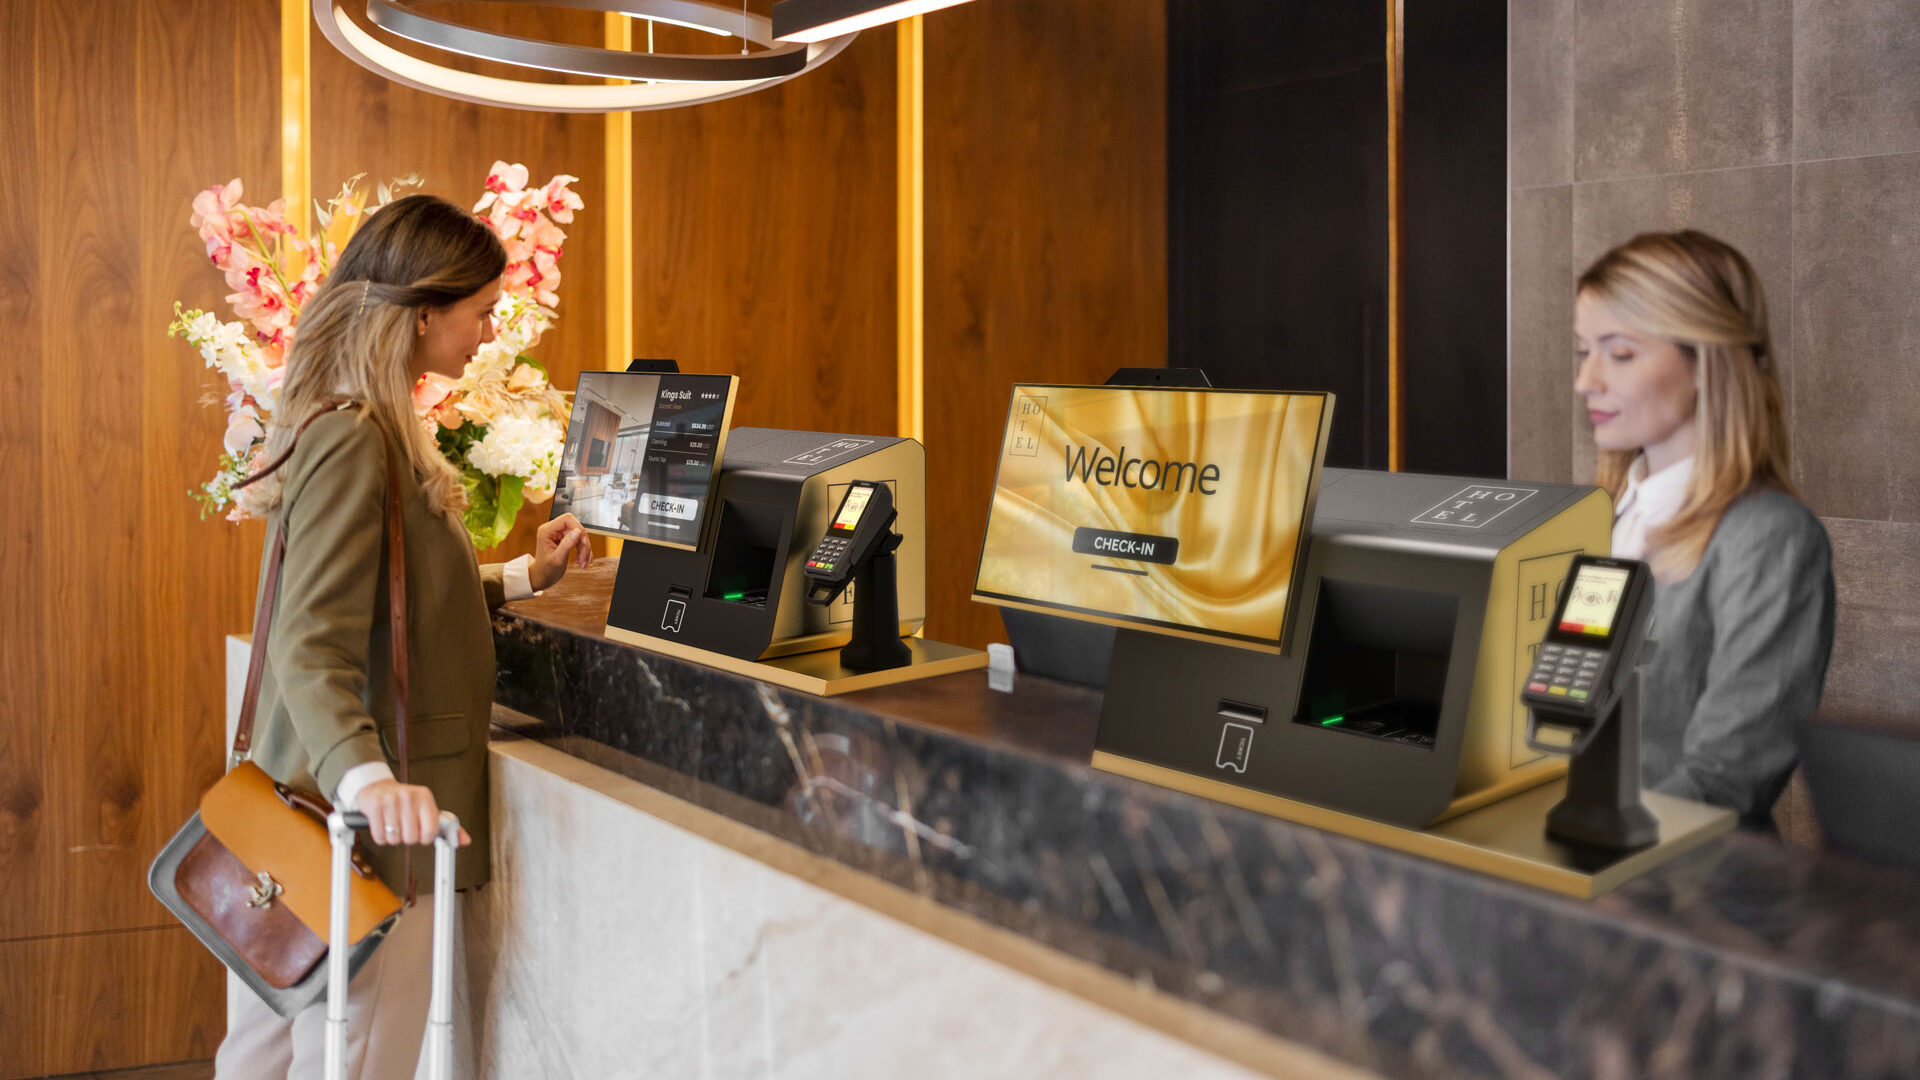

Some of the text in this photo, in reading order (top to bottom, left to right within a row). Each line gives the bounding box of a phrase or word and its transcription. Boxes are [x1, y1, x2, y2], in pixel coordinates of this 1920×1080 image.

[660, 389, 692, 402] Kings Suit
[1065, 444, 1221, 496] Welcome
[650, 500, 686, 514] CHECK-IN
[1094, 536, 1155, 556] CHECK-IN
